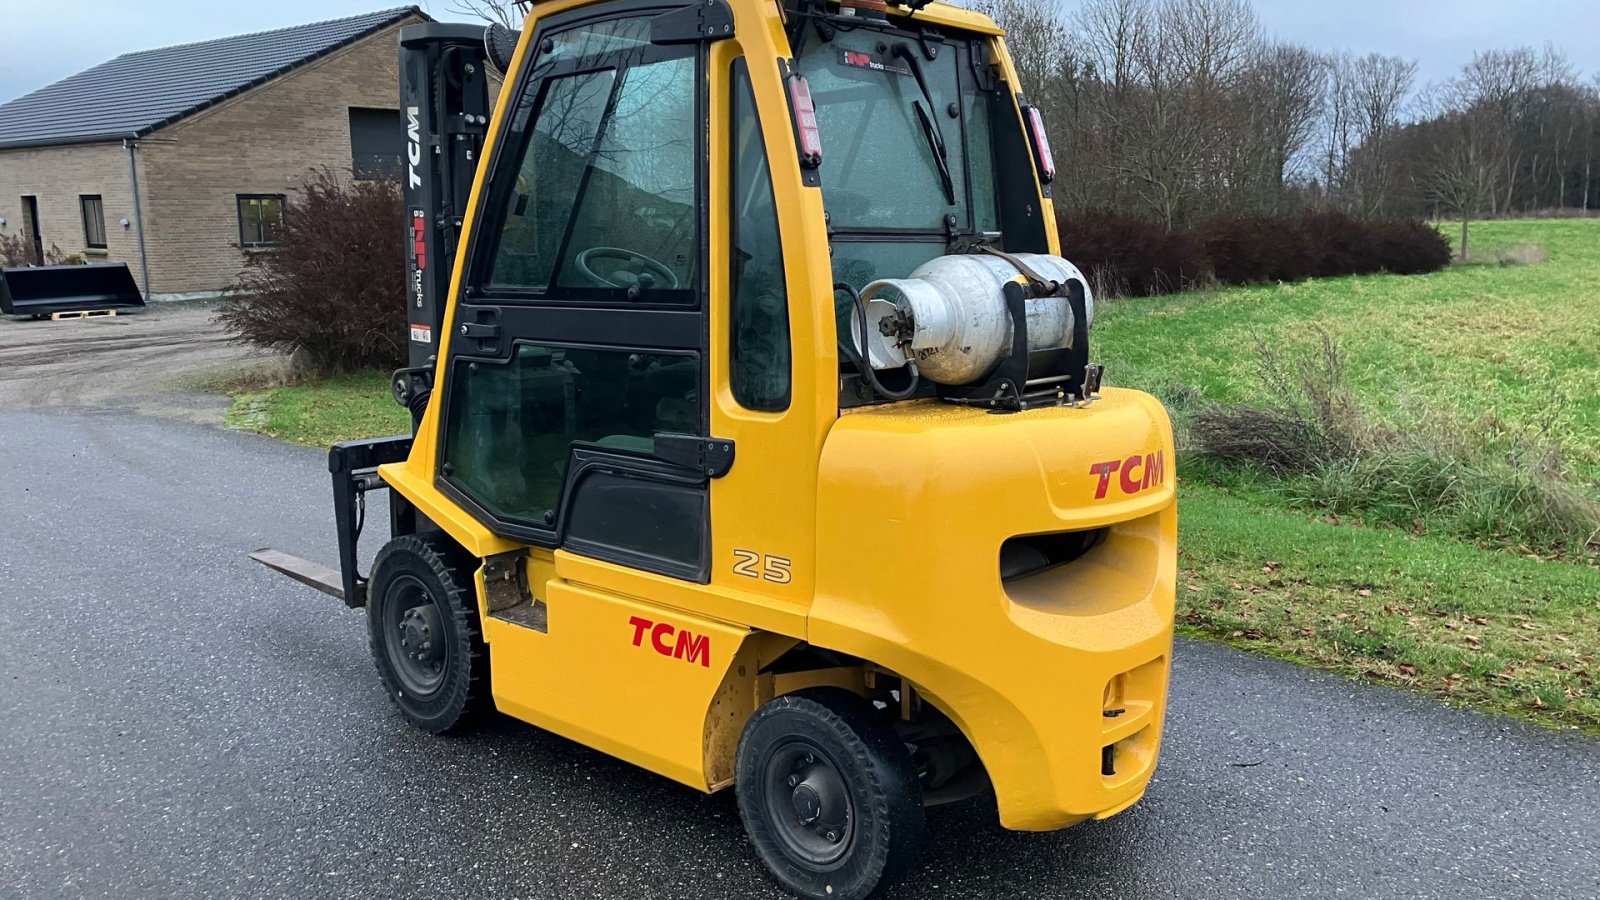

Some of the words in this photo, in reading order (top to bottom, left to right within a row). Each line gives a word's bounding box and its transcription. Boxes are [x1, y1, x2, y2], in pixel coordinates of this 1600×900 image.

[407, 107, 421, 190] TCM
[414, 269, 424, 308] trucks
[1089, 448, 1164, 500] TCM
[733, 548, 792, 584] 25
[628, 615, 710, 668] TCM
